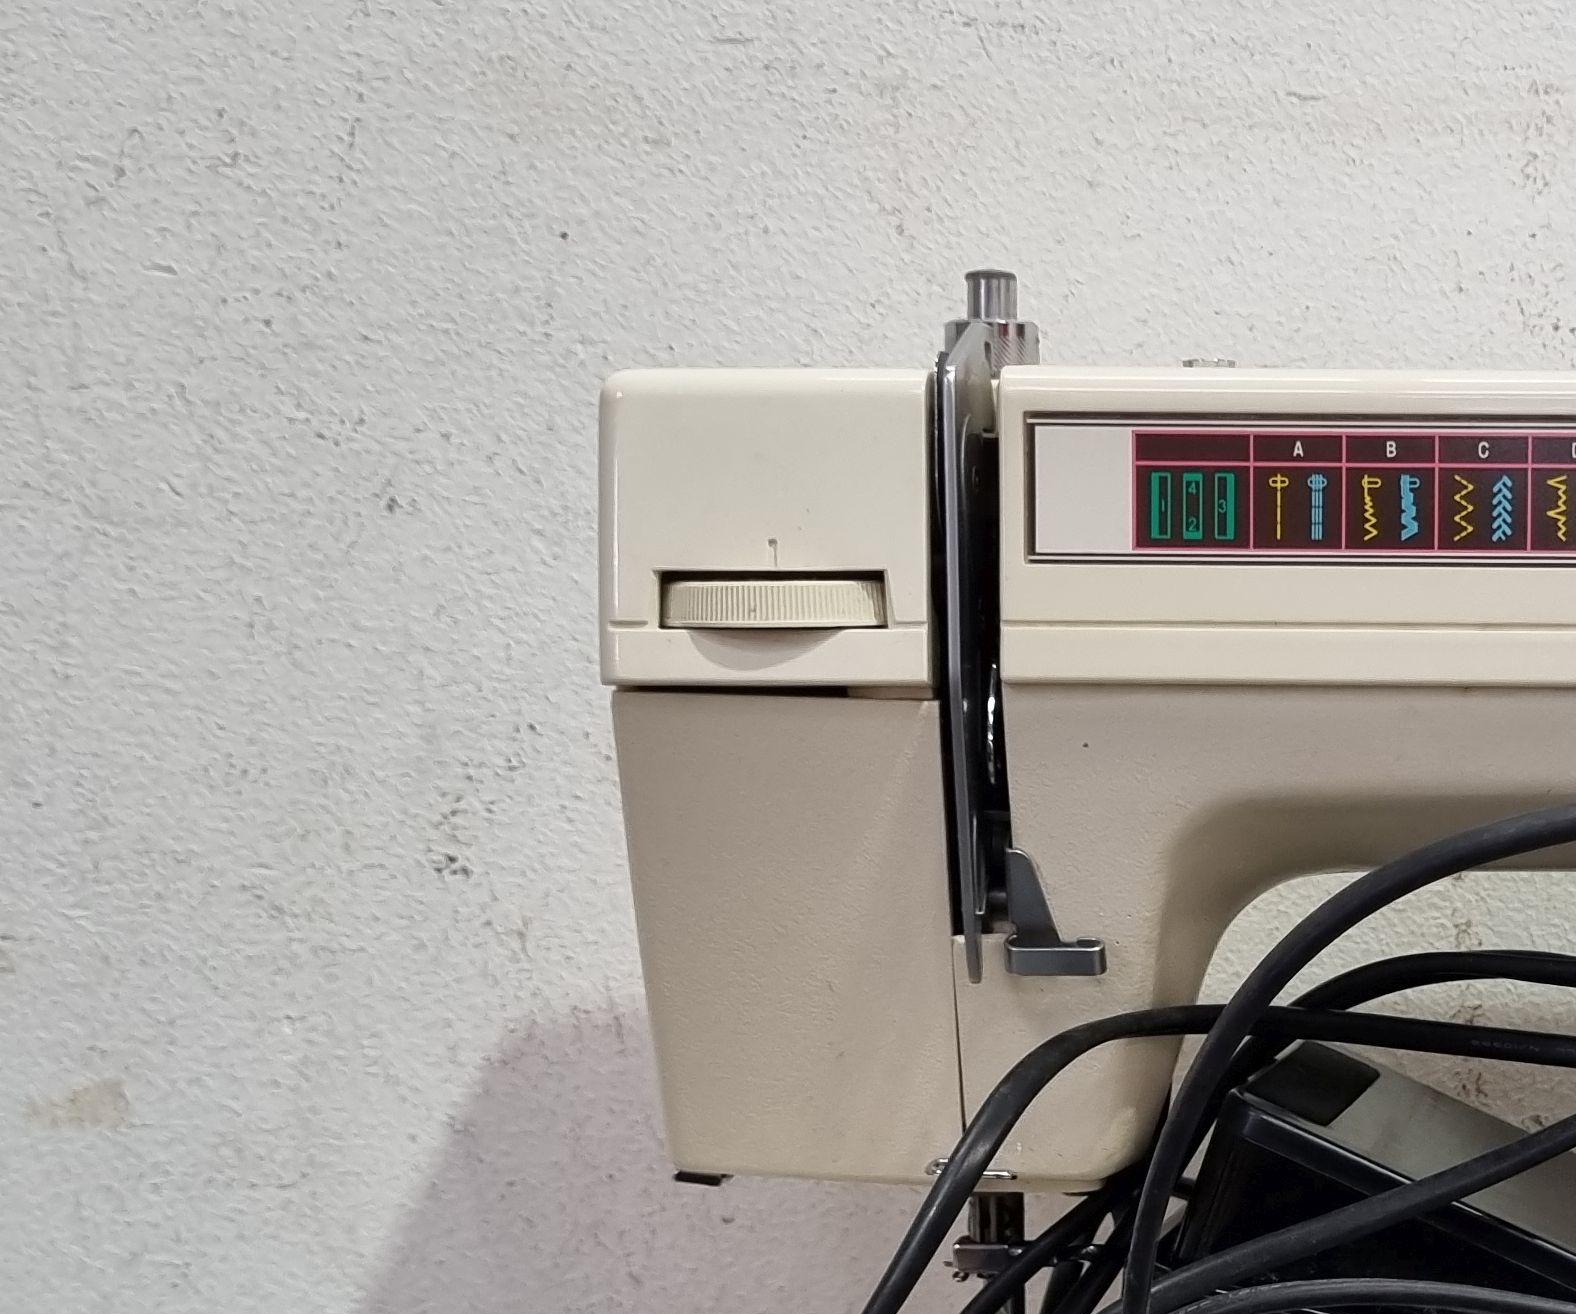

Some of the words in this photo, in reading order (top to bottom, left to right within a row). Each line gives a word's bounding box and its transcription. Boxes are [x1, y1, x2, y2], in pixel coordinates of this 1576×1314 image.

[1293, 441, 1304, 459] A
[1386, 441, 1396, 459] B
[1478, 441, 1489, 459] C
[1188, 481, 1197, 495] 4
[1218, 499, 1227, 514] 3
[1188, 517, 1197, 532] 2
